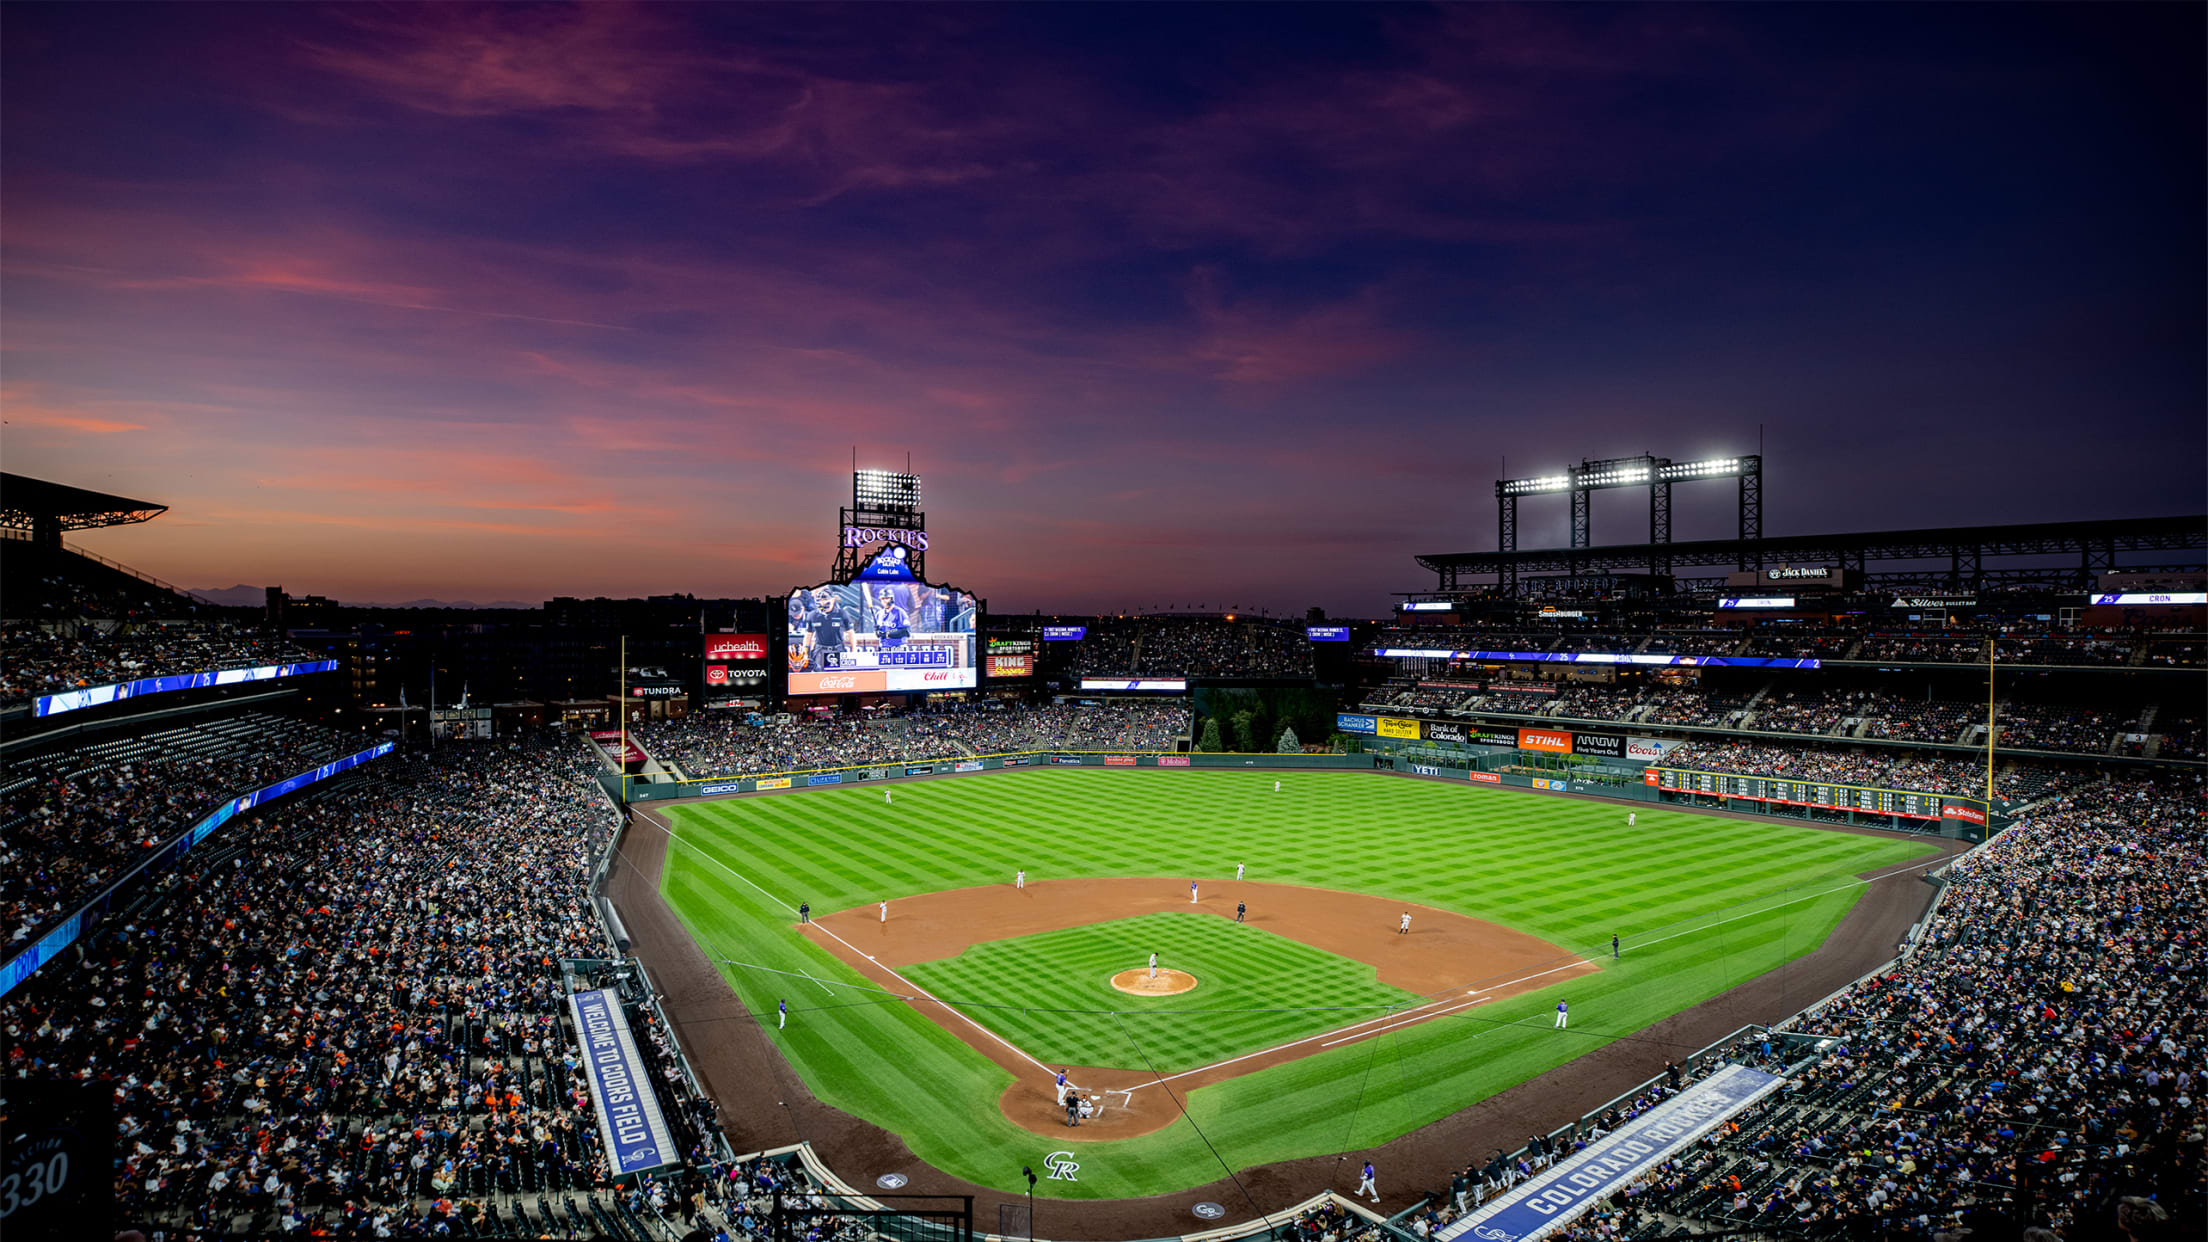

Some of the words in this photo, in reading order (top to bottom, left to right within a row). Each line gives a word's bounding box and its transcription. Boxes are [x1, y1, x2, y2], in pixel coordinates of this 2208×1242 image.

[844, 527, 928, 551] ROCKIES
[1910, 598, 1945, 607] Silver
[714, 640, 760, 652] uchealth
[995, 657, 1024, 667] KING
[1560, 653, 1568, 661] 25
[728, 669, 767, 677] TOYOTA
[924, 672, 949, 681] Chill
[643, 687, 681, 695] TUNDRA
[1430, 724, 1447, 732] Bank
[1448, 725, 1458, 733] of
[1430, 732, 1465, 742] Colorado
[1470, 732, 1515, 740] DRAFTKINGS
[1525, 735, 1565, 746] STIHL
[1577, 736, 1620, 748] ARROW
[1606, 748, 1619, 756] Out
[1628, 743, 1658, 756] Coors
[1415, 765, 1438, 776] YETI
[702, 784, 737, 794] GEICO
[584, 1003, 614, 1048] WELCOME
[596, 1049, 620, 1064] TO
[601, 1063, 634, 1104] COORS
[612, 1105, 647, 1145] FIELD
[1526, 1139, 1654, 1215] COLORADO
[1645, 1094, 1733, 1144] ROCKIES
[1044, 1150, 1080, 1182] CR
[0, 1151, 68, 1218] 330
